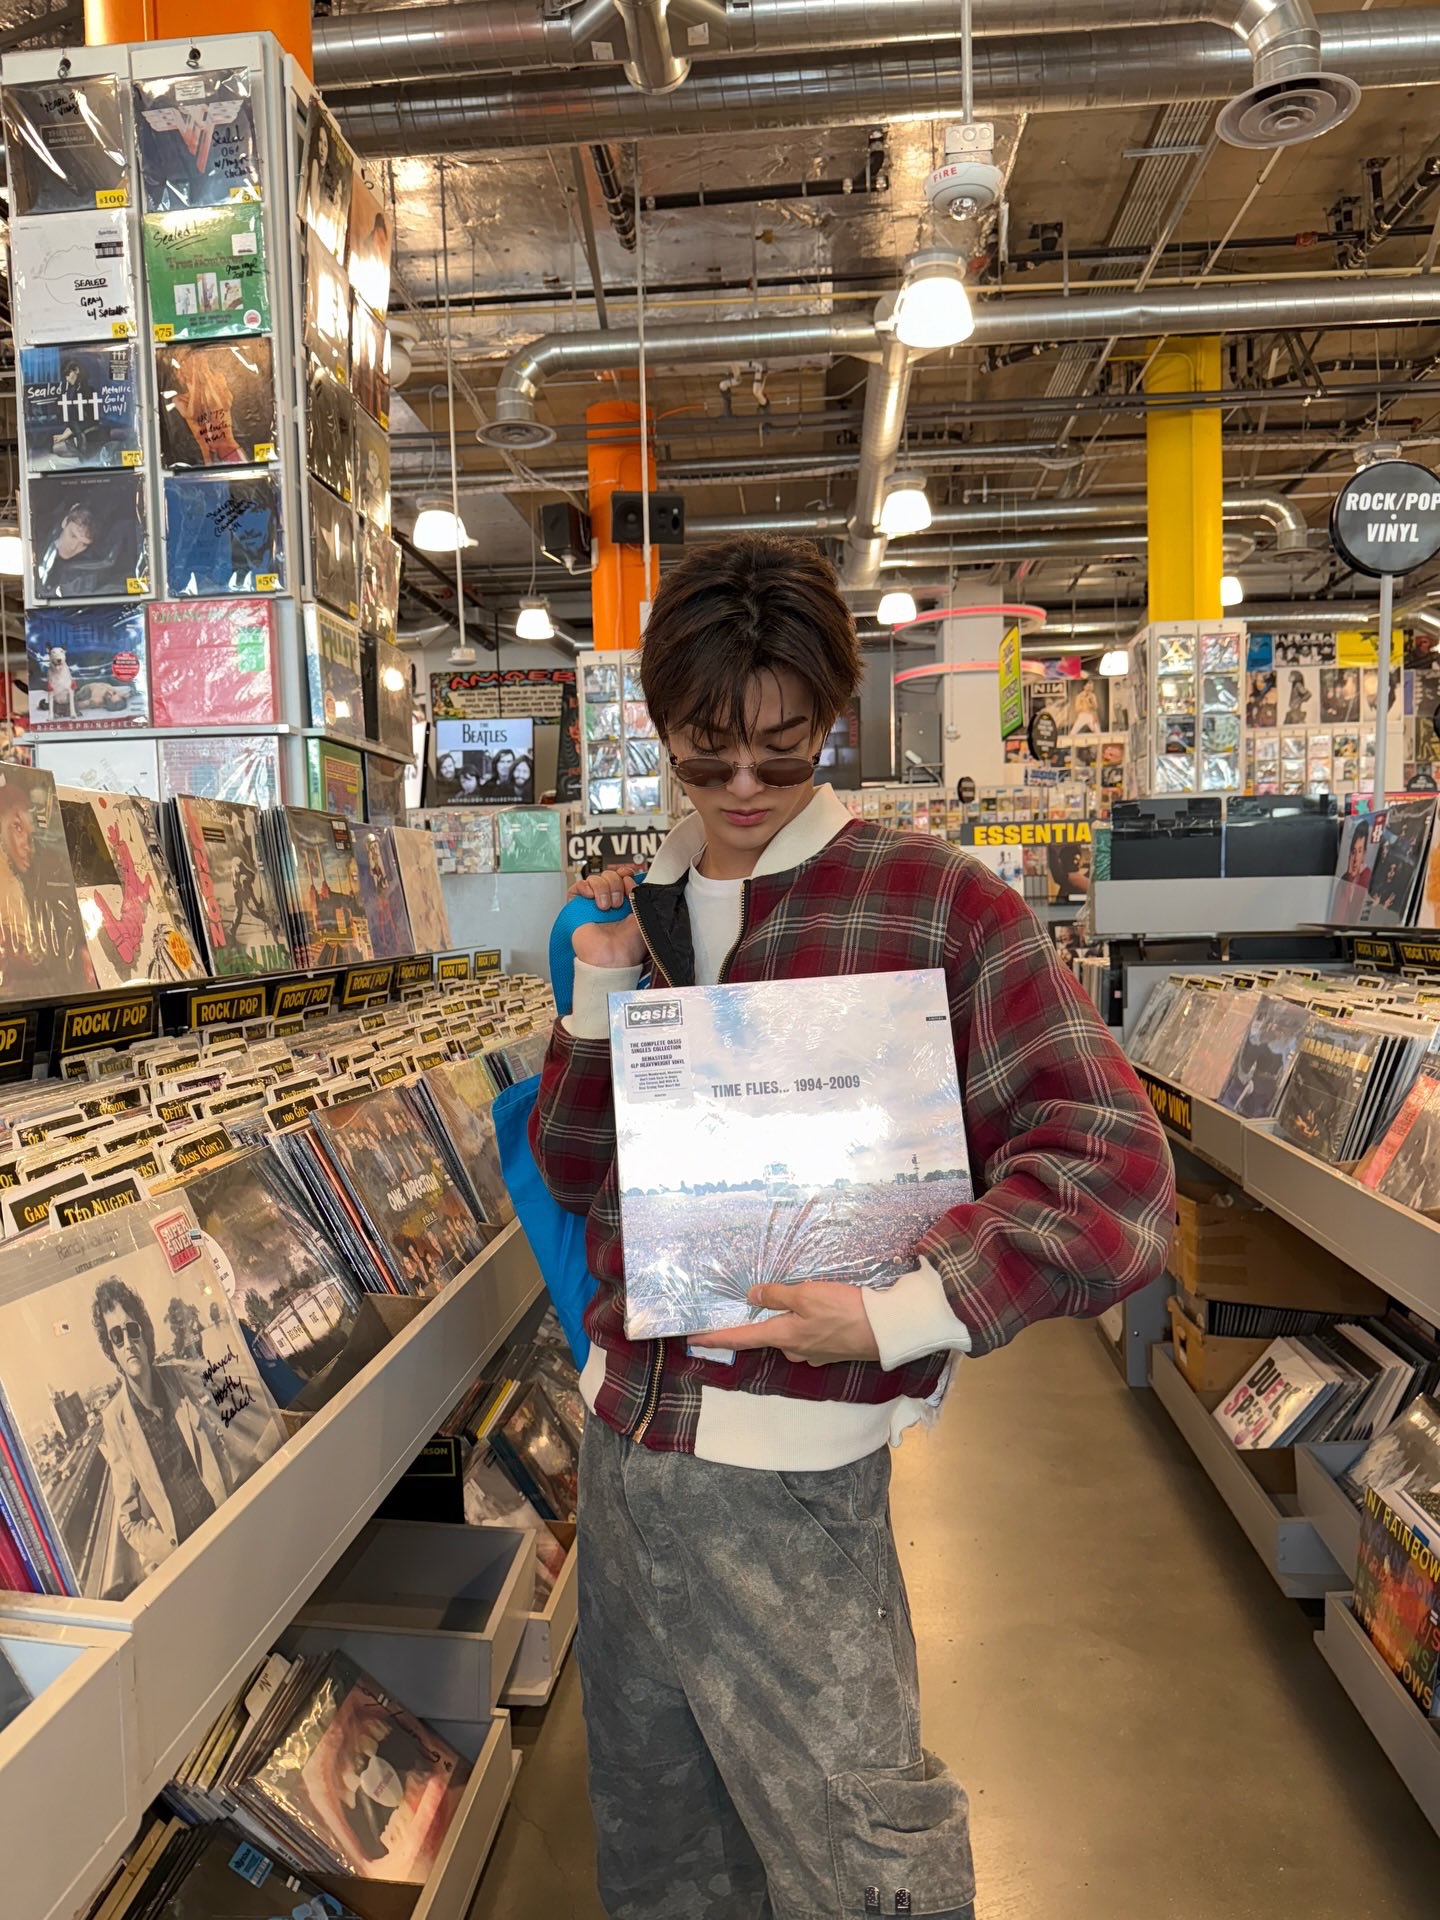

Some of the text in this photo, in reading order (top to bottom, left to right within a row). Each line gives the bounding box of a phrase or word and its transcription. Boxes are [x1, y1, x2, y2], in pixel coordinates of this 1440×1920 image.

[933, 166, 958, 183] FIRE
[99, 195, 124, 204] $100
[74, 278, 106, 288] SEALED
[155, 328, 172, 338] $75
[103, 402, 127, 416] Vinyl
[104, 395, 125, 404] Gold
[1367, 523, 1419, 543] VINYL
[37, 724, 61, 732] RICK
[462, 723, 508, 746] BEATLES
[973, 822, 1092, 846] ESSENTIA
[568, 835, 603, 860] CK
[353, 976, 371, 991] ROCK
[375, 972, 388, 985] POP
[283, 991, 306, 1009] ROCK
[311, 987, 327, 1003] POP
[201, 999, 230, 1022] ROCK
[239, 998, 259, 1015] POP
[630, 1005, 677, 1021] oasis
[72, 1011, 111, 1037] ROCK
[122, 1005, 147, 1027] POP
[640, 1060, 671, 1068] HEAVYWEIGHT
[641, 1054, 673, 1062] REMASTERED
[712, 1075, 860, 1098] TIME FLIES... 1994-2009
[161, 1104, 183, 1121] BETH
[283, 1112, 295, 1123] 100
[1152, 1087, 1166, 1114] POP
[1168, 1093, 1191, 1130] VINYL
[179, 1138, 226, 1167] OASIS (CONT.)
[387, 1172, 440, 1211] ONE DIRECTION
[24, 1204, 49, 1223] GARY
[64, 1189, 136, 1225] TED NUGENT
[160, 1219, 189, 1240] SUPER
[287, 1324, 304, 1341] BELIEVE
